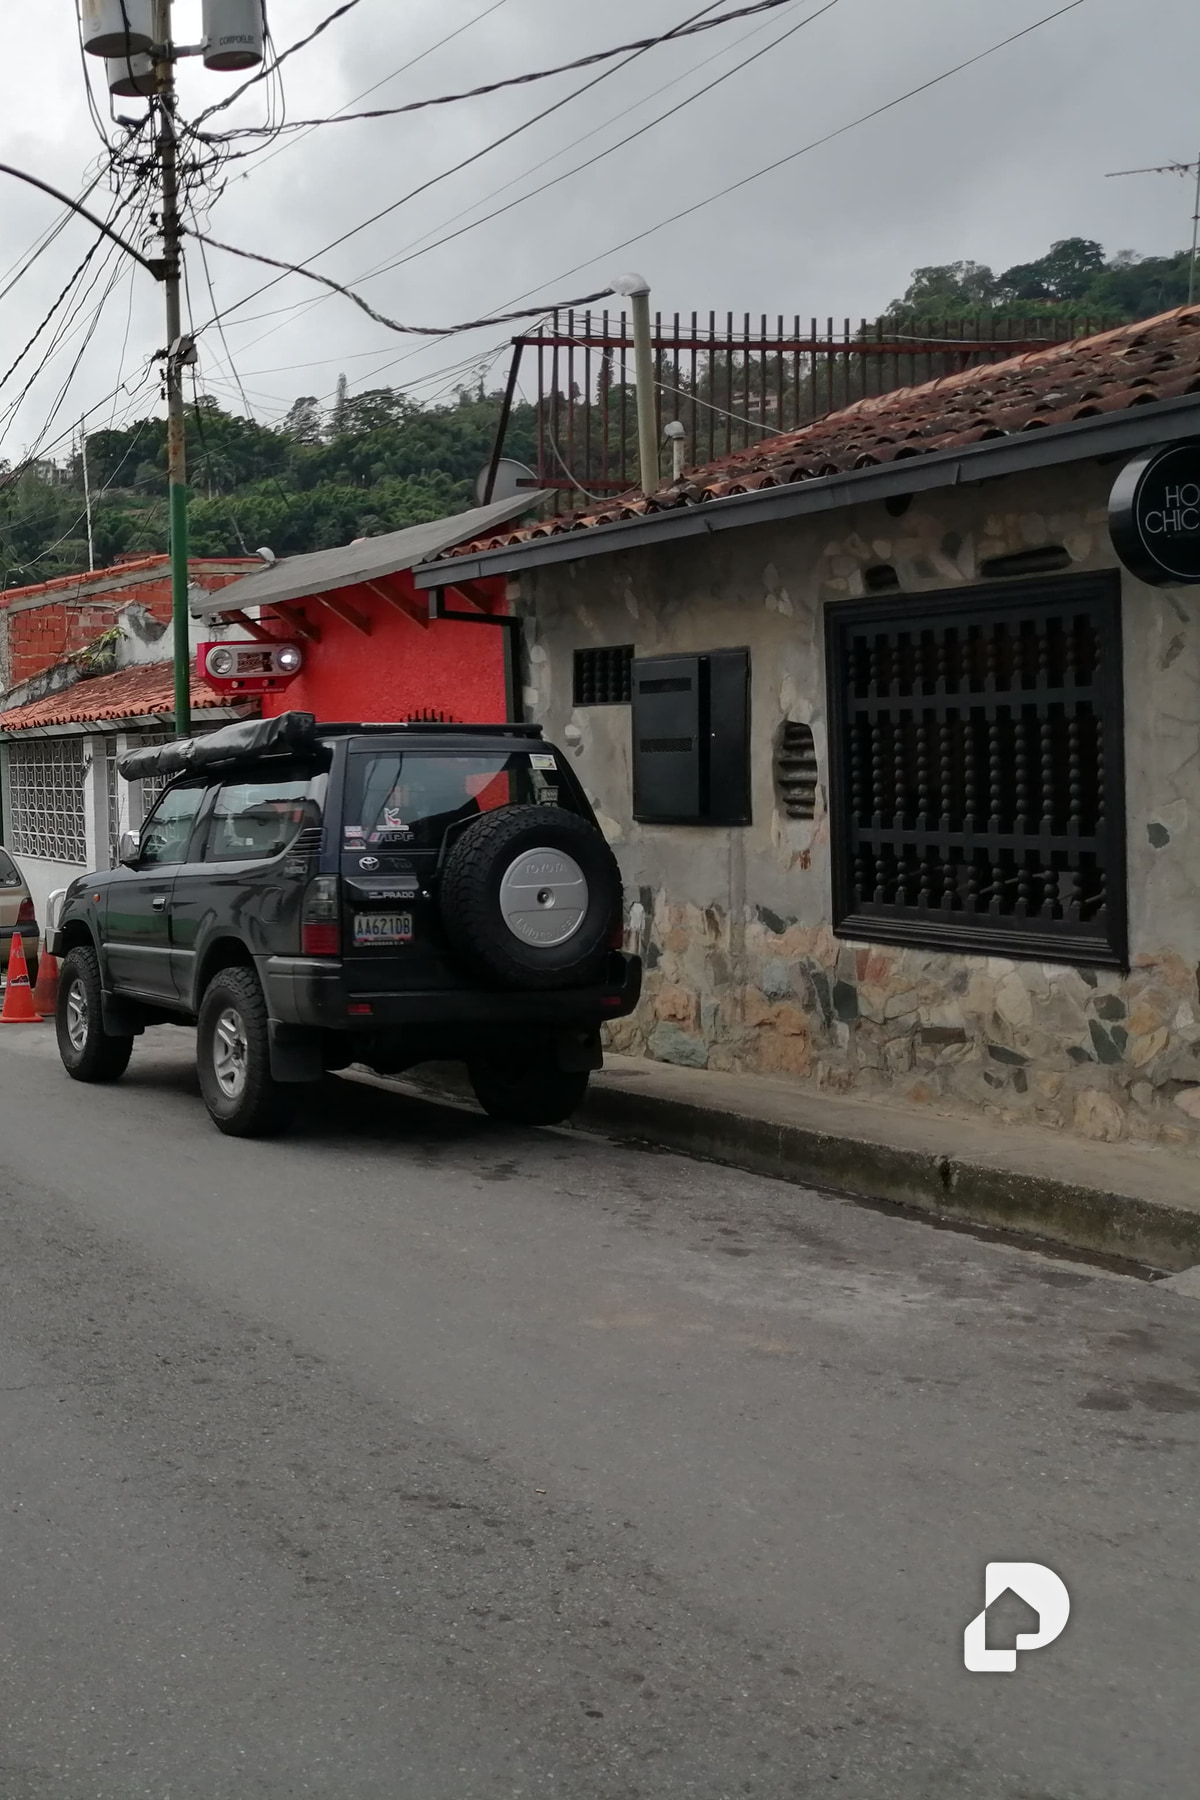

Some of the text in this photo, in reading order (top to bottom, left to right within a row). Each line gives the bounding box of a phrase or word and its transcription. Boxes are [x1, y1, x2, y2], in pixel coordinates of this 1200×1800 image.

[526, 863, 568, 874] TOYOTA
[383, 891, 415, 899] PRADO
[356, 917, 411, 936] AA621DB
